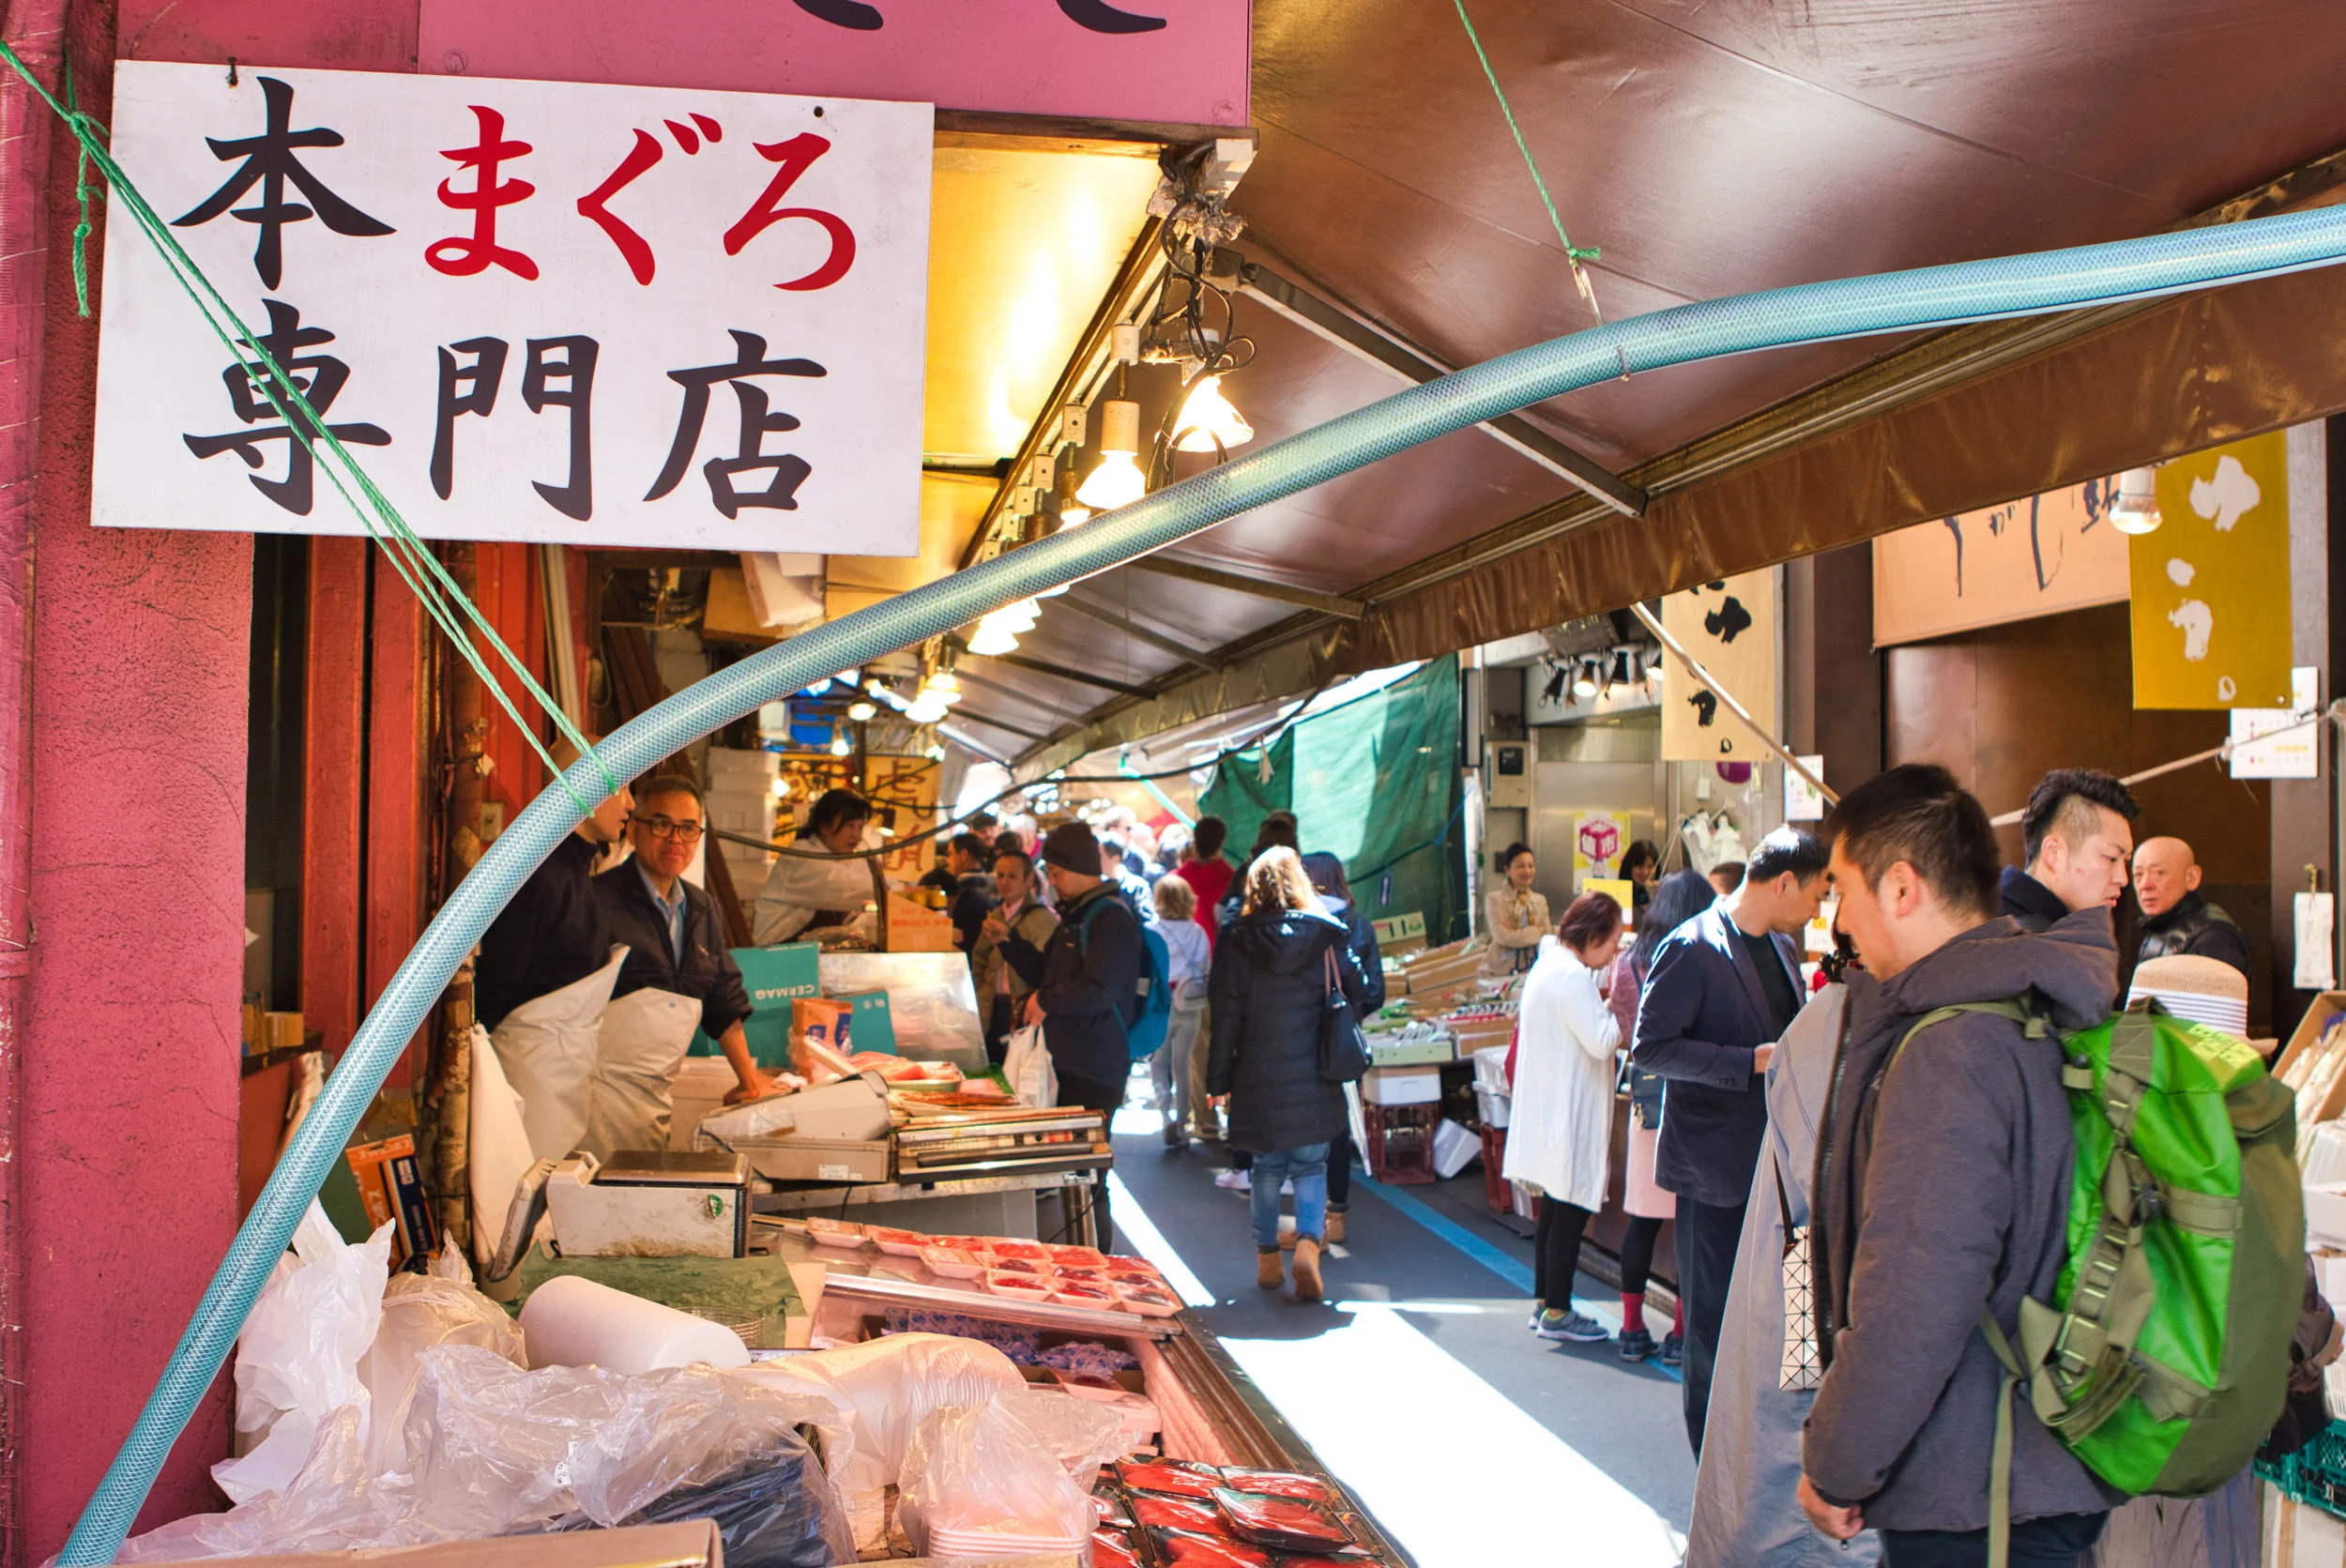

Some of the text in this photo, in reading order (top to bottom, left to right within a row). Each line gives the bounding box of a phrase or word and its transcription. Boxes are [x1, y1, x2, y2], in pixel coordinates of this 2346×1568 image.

[170, 75, 858, 292] 本まぐろ
[182, 297, 828, 523] 専門店
[754, 983, 815, 1000] CERMAQ
